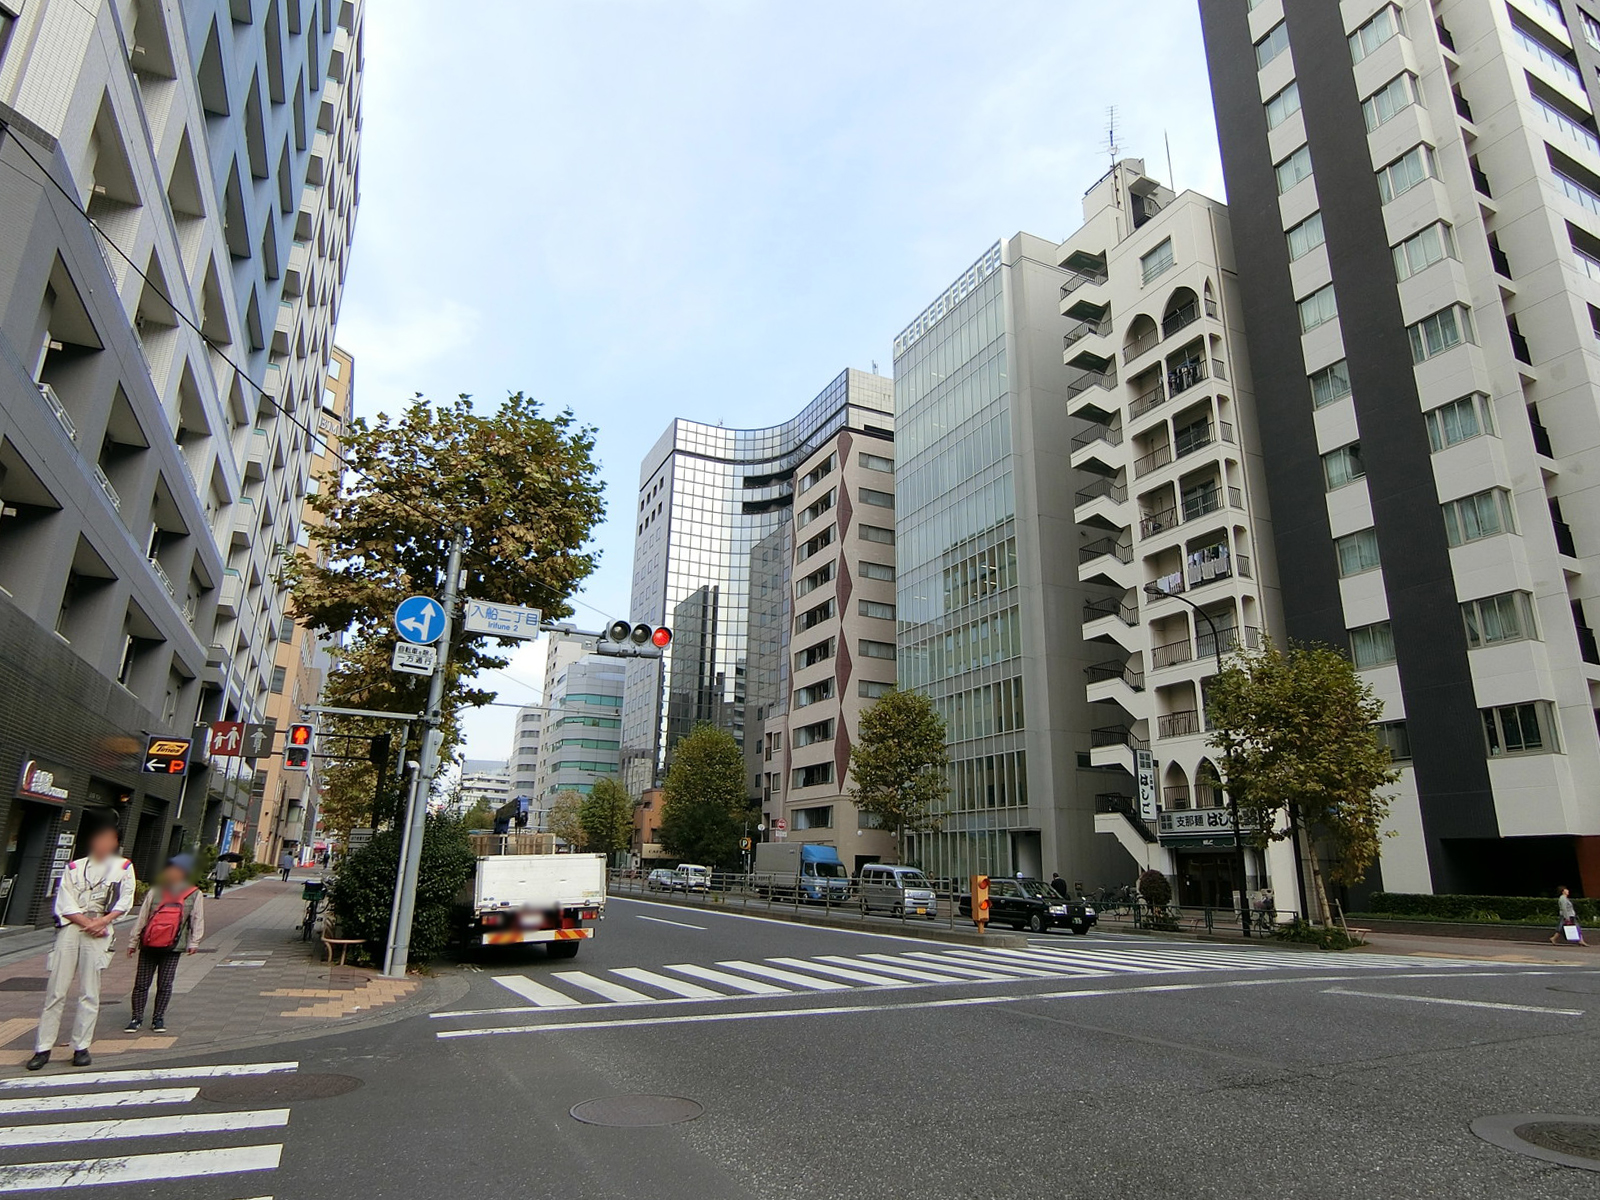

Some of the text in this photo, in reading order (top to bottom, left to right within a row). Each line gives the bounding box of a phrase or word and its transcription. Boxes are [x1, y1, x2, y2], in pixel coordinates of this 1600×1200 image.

[470, 605, 538, 626] 入船二丁目
[488, 621, 511, 631] Irifune
[397, 655, 431, 666] 一方通行
[156, 744, 184, 753] Times
[169, 760, 185, 774] P
